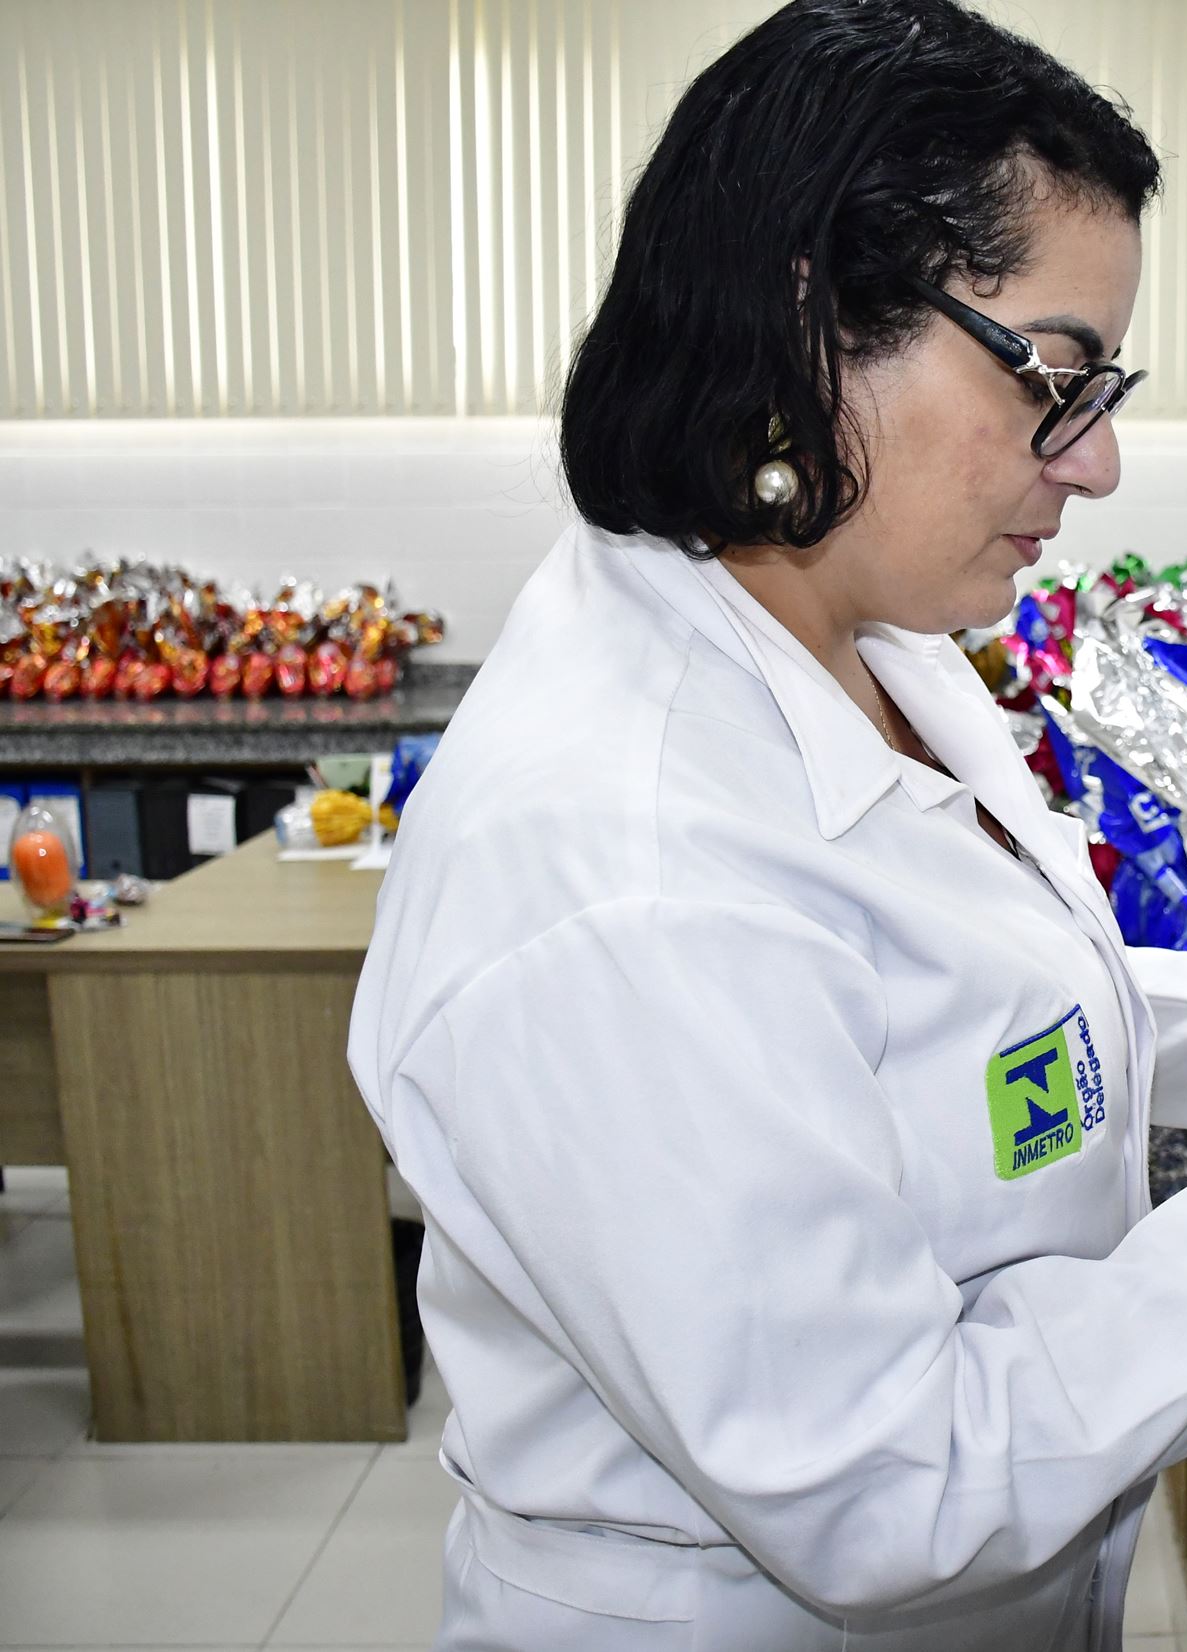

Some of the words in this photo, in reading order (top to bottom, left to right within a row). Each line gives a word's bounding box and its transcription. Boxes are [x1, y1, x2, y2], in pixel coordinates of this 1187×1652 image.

[1076, 1060, 1094, 1132] Órgão
[1077, 1015, 1106, 1124] Delegado
[1012, 1122, 1075, 1171] INMETRO
